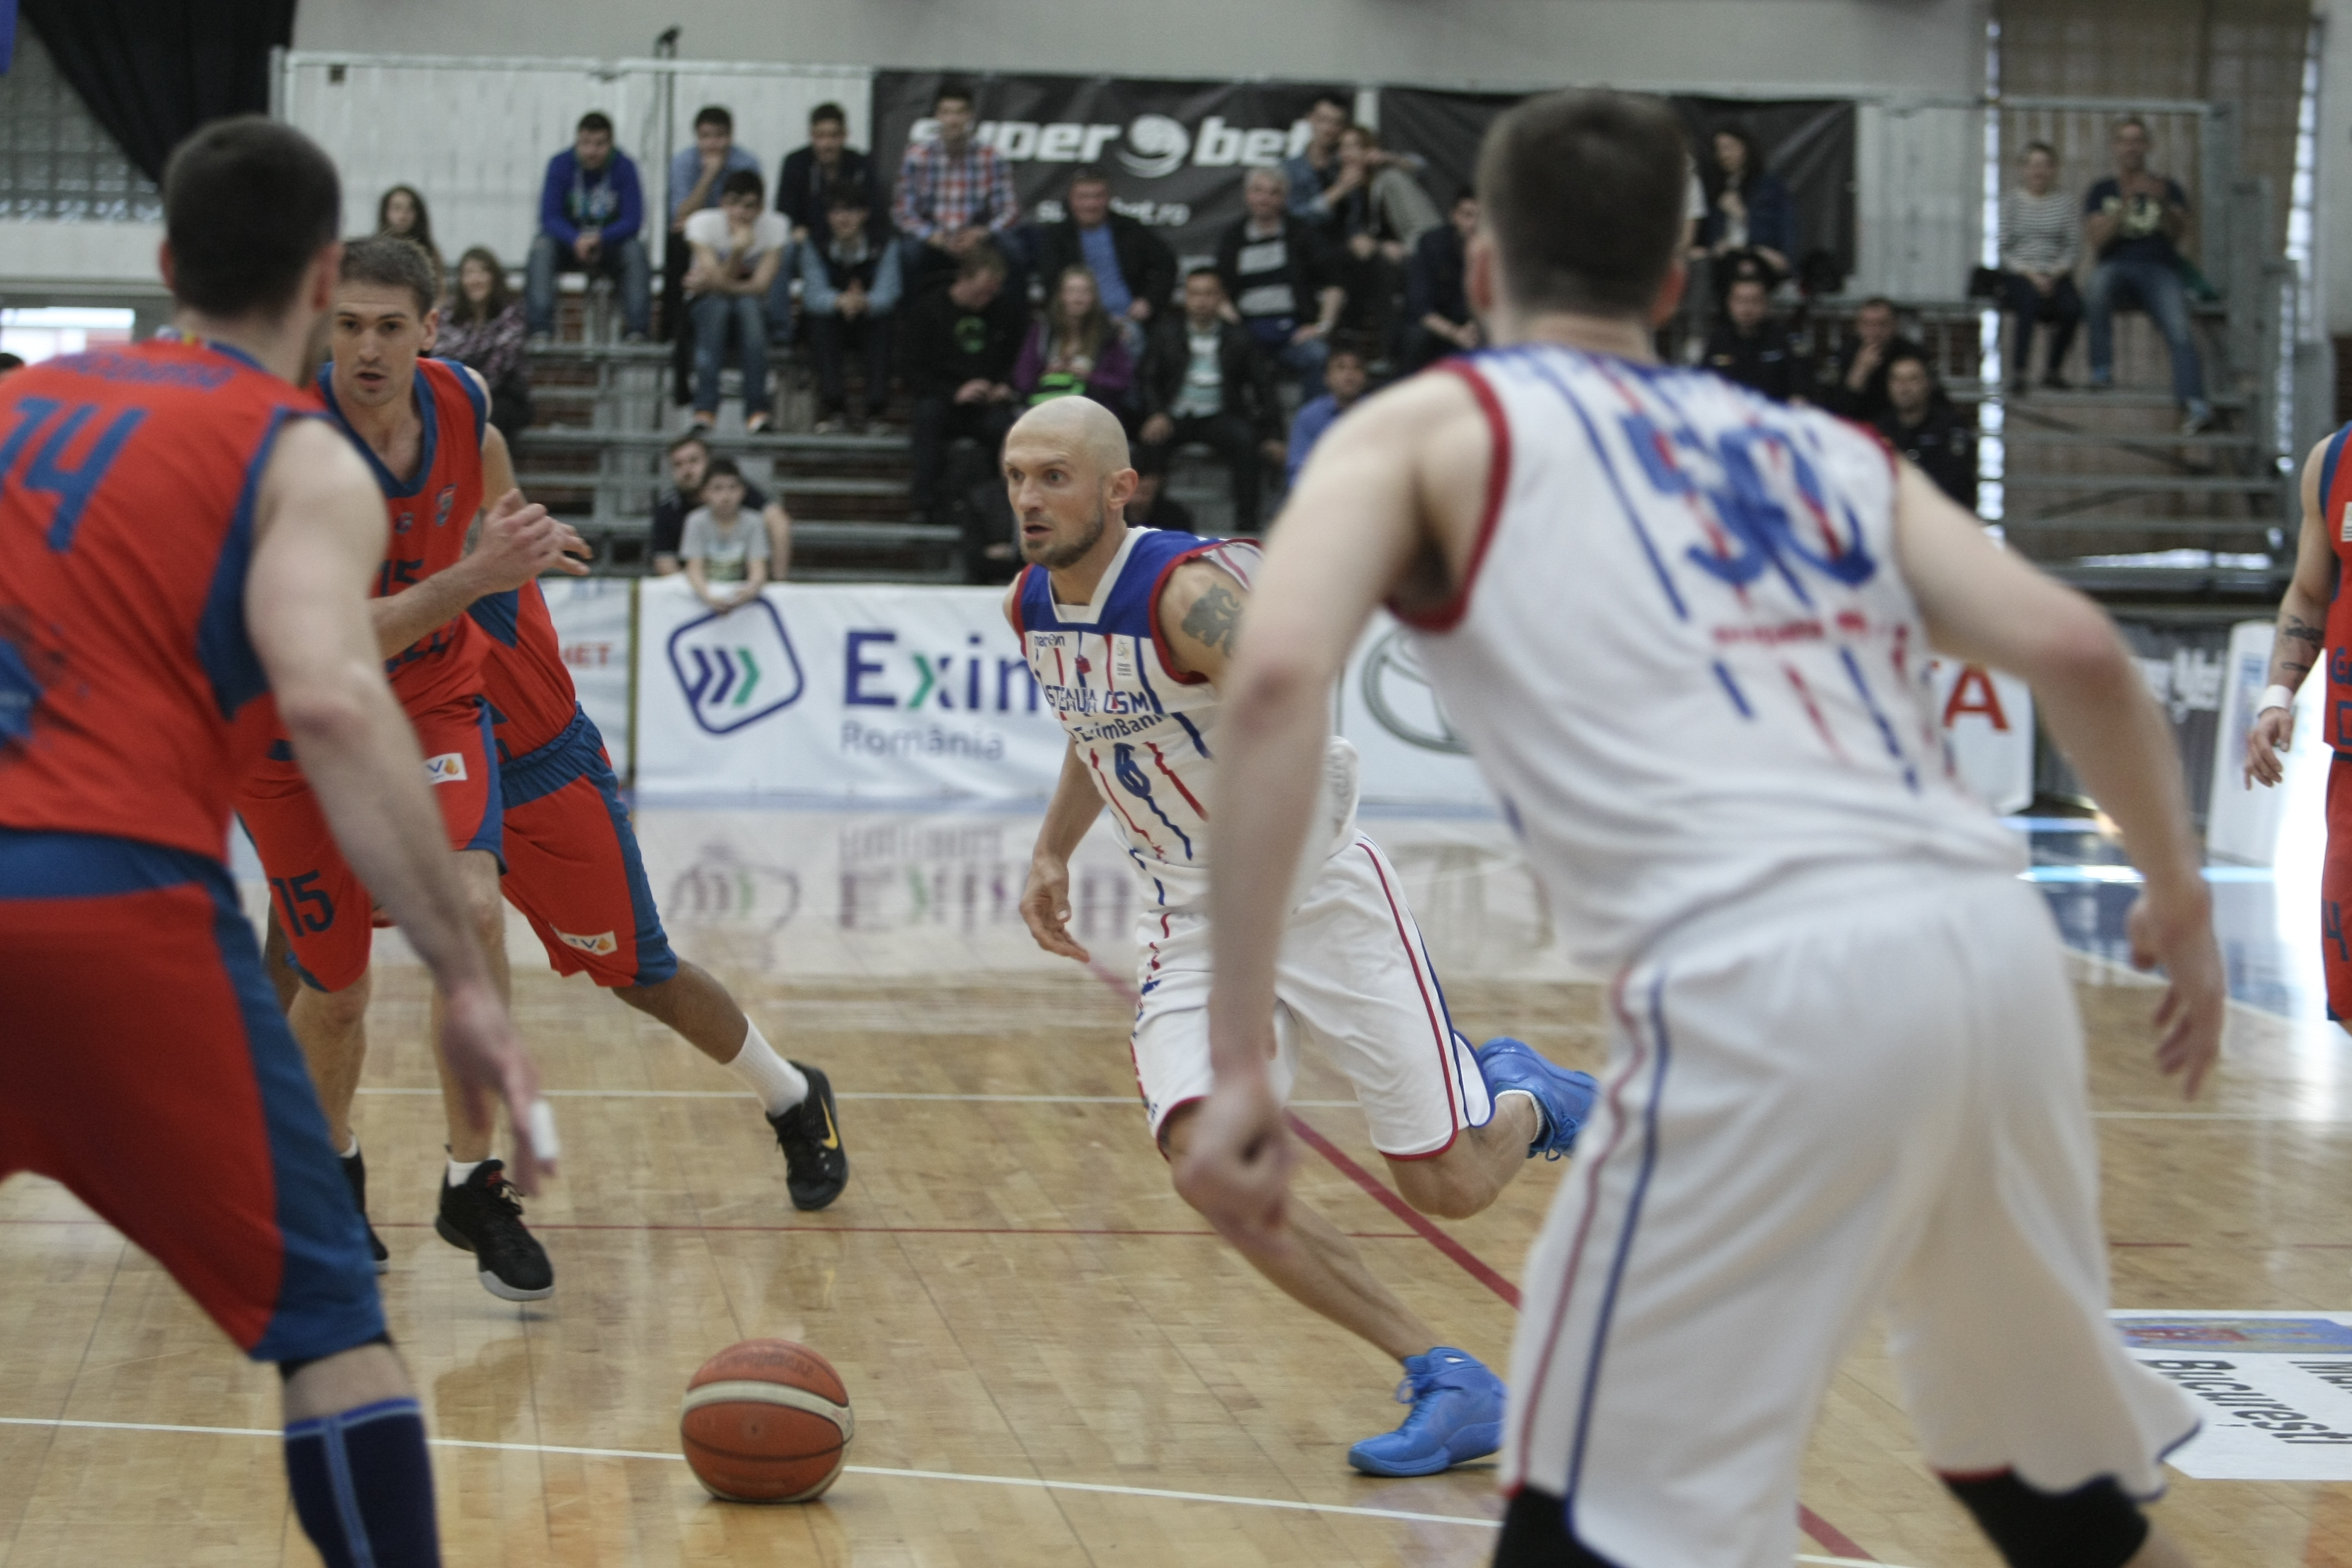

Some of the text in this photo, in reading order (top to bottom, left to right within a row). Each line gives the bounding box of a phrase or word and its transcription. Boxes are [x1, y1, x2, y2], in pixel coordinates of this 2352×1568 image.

[0, 397, 149, 553] 14
[1045, 685, 1150, 715] STEAUA CSM
[841, 723, 1003, 759] România
[1114, 742, 1152, 798] 6
[270, 869, 335, 938] 15
